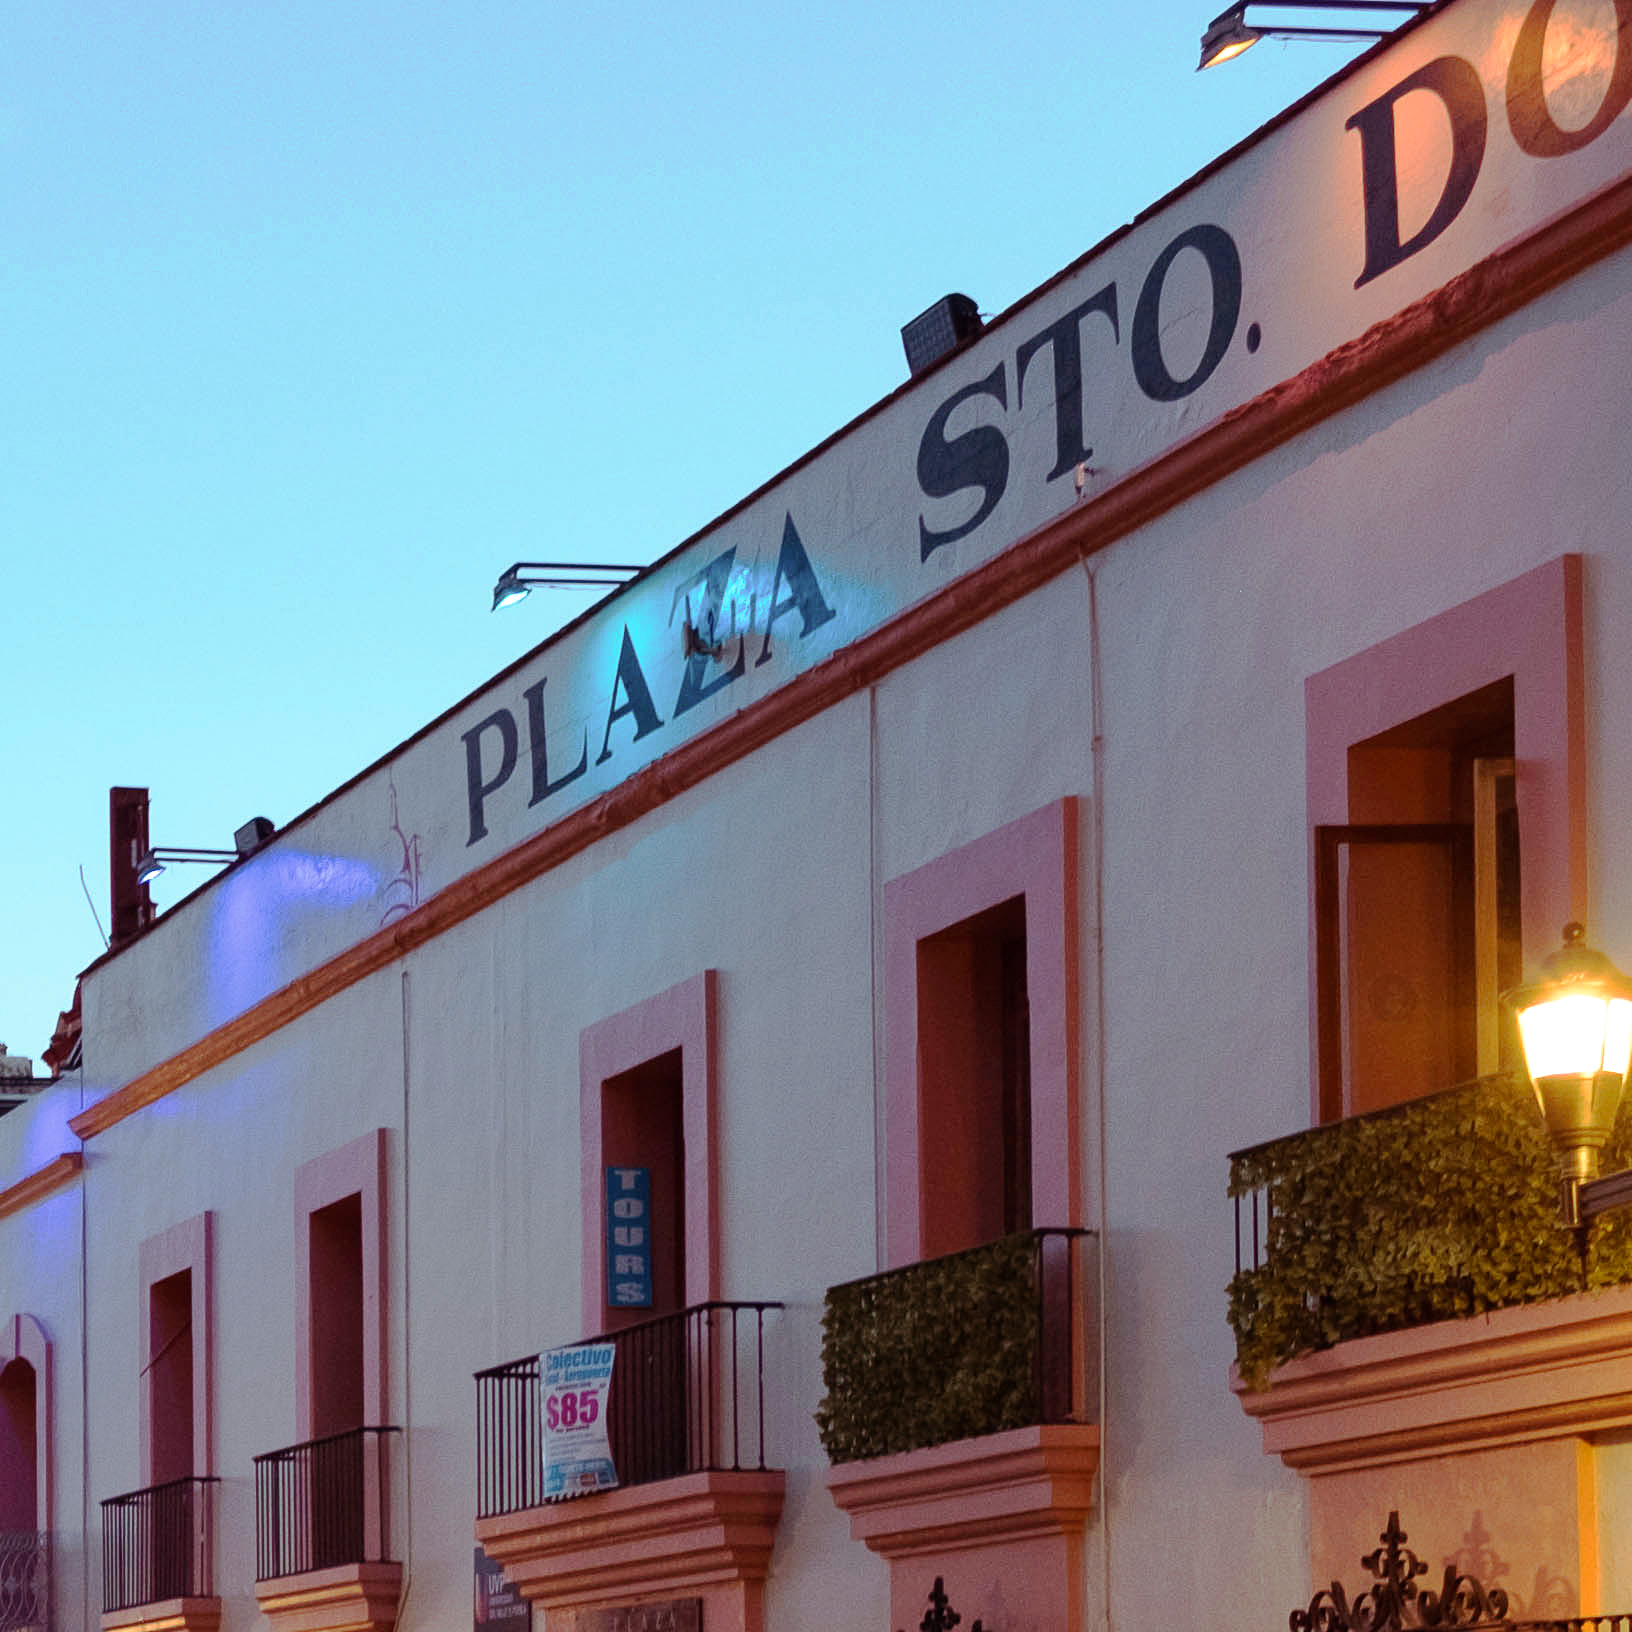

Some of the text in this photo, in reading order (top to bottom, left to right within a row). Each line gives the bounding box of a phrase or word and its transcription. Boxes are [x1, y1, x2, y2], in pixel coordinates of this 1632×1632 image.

[458, 509, 837, 847] PLAZA
[915, 222, 1263, 564] STO.
[613, 1168, 645, 1304] TOURS
[547, 1389, 599, 1430] $85
